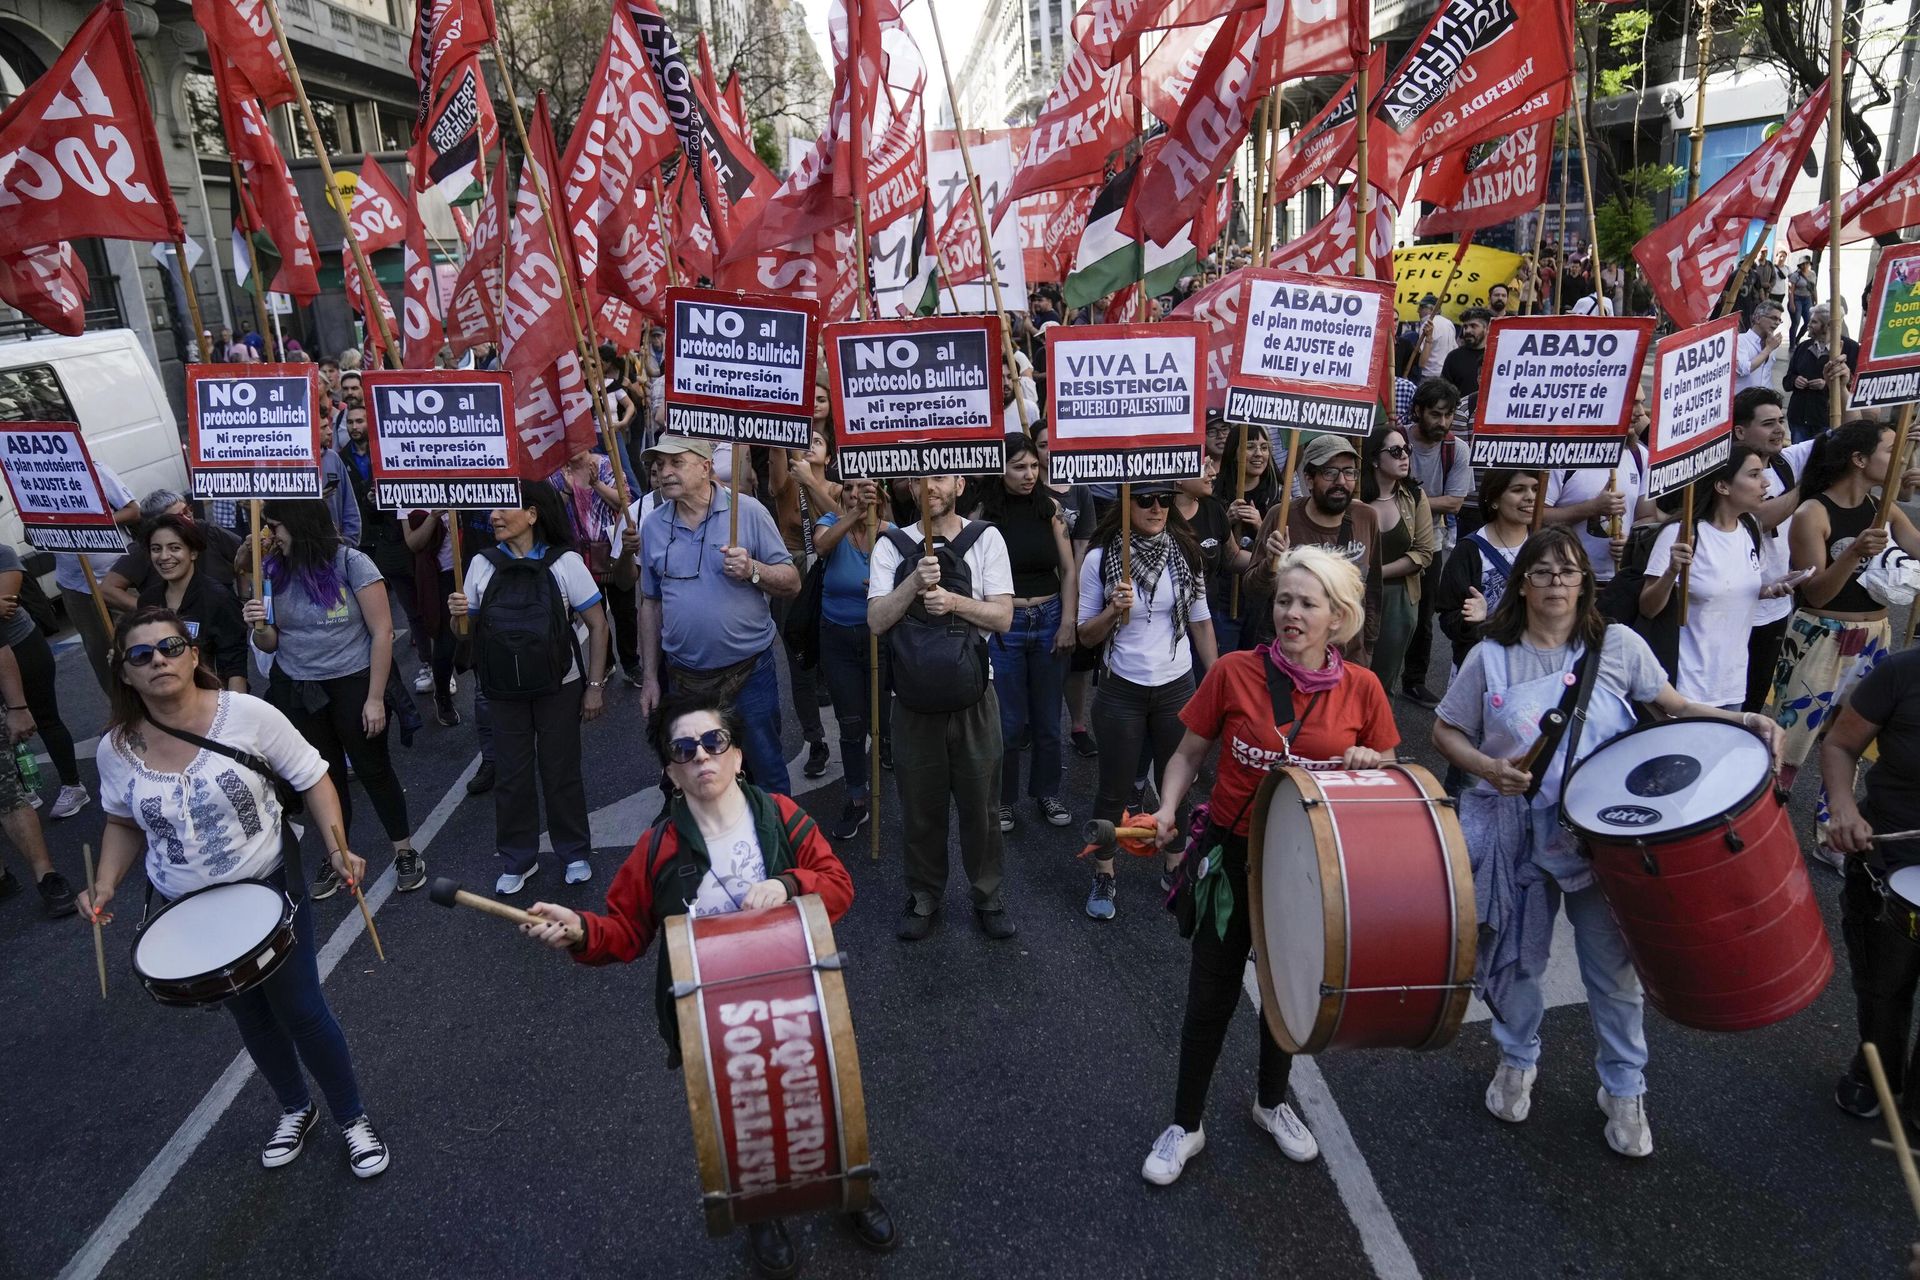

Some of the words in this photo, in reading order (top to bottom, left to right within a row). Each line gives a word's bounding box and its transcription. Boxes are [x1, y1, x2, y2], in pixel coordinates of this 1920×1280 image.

[1270, 286, 1363, 317] ABAJO
[1398, 293, 1484, 307] IZDOS
[689, 307, 745, 338] NO
[759, 320, 777, 338] al
[1252, 310, 1265, 326] el
[1267, 312, 1298, 332] plan
[1300, 318, 1372, 338] motosierra
[680, 337, 744, 360] protocolo
[747, 342, 800, 366] Bullrich
[854, 340, 919, 370] NO
[937, 342, 955, 361] al
[1264, 334, 1281, 350] de
[1284, 336, 1336, 356] AJUSTE
[1338, 342, 1354, 358] de
[1517, 334, 1618, 357] ABAJO
[1675, 336, 1726, 376] ABAJO
[694, 363, 709, 377] Ni
[713, 367, 782, 384] represión
[1066, 353, 1136, 377] VIVA
[1146, 352, 1179, 374] LA
[1261, 354, 1299, 372] MILEI
[1301, 360, 1311, 376] y
[1313, 359, 1325, 375] el
[1328, 361, 1352, 378] FMI
[1497, 360, 1511, 377] el
[1513, 360, 1546, 380] plan
[1550, 359, 1627, 377] motosierra
[677, 378, 691, 391] Ni
[695, 381, 799, 402] criminalización
[848, 369, 921, 394] protocolo
[926, 364, 984, 389] Bullrich
[1060, 377, 1188, 396] RESISTENCIA
[1509, 383, 1528, 398] de
[1531, 383, 1587, 399] AJUSTE
[1590, 383, 1608, 398] de
[1663, 383, 1672, 400] el
[1674, 378, 1692, 399] plan
[1693, 362, 1730, 390] motosierra
[1854, 371, 1918, 407] IZQUIERDA
[209, 383, 256, 407] NO
[269, 386, 284, 402] al
[388, 389, 444, 415] NO
[458, 393, 475, 410] al
[868, 399, 885, 415] Ni
[889, 396, 967, 415] represión
[1060, 404, 1070, 413] del
[1072, 400, 1118, 416] PUEBLO
[1121, 397, 1184, 415] PALESTINO
[1673, 402, 1683, 419] de
[1685, 390, 1714, 413] AJUSTE
[1714, 384, 1722, 400] de
[203, 406, 258, 427] protocolo
[260, 404, 306, 425] Bullrich
[849, 416, 866, 432] Ni
[870, 413, 988, 430] criminalización
[1230, 392, 1299, 423] IZQUIERDA
[1301, 401, 1369, 429] SOCIALISTA
[1506, 403, 1547, 419] MILEI
[1547, 405, 1560, 422] y
[1561, 403, 1576, 419] el
[1577, 403, 1604, 419] FMI
[1671, 416, 1693, 439] MILEI
[1694, 414, 1700, 434] y
[1701, 409, 1708, 426] el
[1709, 403, 1721, 422] FMI
[383, 416, 447, 438] protocolo
[449, 413, 501, 434] Bullrich
[669, 408, 735, 437] IZQUIERDA
[738, 416, 809, 445] SOCIALISTA
[7, 435, 68, 455] ABAJO
[216, 431, 229, 444] Ni
[232, 430, 292, 446] represión
[400, 441, 415, 453] Ni
[419, 440, 486, 455] represión
[203, 446, 216, 459] Ni
[218, 444, 309, 458] criminalización
[385, 455, 400, 468] Ni
[403, 455, 505, 468] criminalización
[843, 450, 919, 478] IZQUIERDA
[922, 447, 1000, 471] SOCIALISTA
[1472, 441, 1547, 467] IZQUIERDA
[1548, 442, 1621, 465] SOCIALISTA
[5, 457, 13, 472] el
[14, 457, 33, 474] plan
[33, 457, 87, 472] motosierra
[1053, 453, 1124, 480] IZQUIERDA
[1127, 451, 1198, 475] SOCIALISTA
[1650, 456, 1694, 495] IZQUIERDA
[1694, 438, 1729, 477] SOCIALISTA
[21, 477, 32, 490] de
[33, 477, 68, 491] AJUSTE
[69, 477, 82, 491] de
[195, 473, 251, 498] IZQUIERDA
[253, 472, 318, 494] SOCIALISTA
[380, 483, 448, 509] IZQUIERDA
[449, 483, 517, 504] SOCIALISTA
[26, 494, 52, 507] MILEI
[52, 496, 60, 511] y
[60, 495, 70, 508] el
[69, 495, 89, 508] FMI
[27, 528, 73, 551] IZQUIERDA
[72, 529, 124, 549] SOCIALISTA
